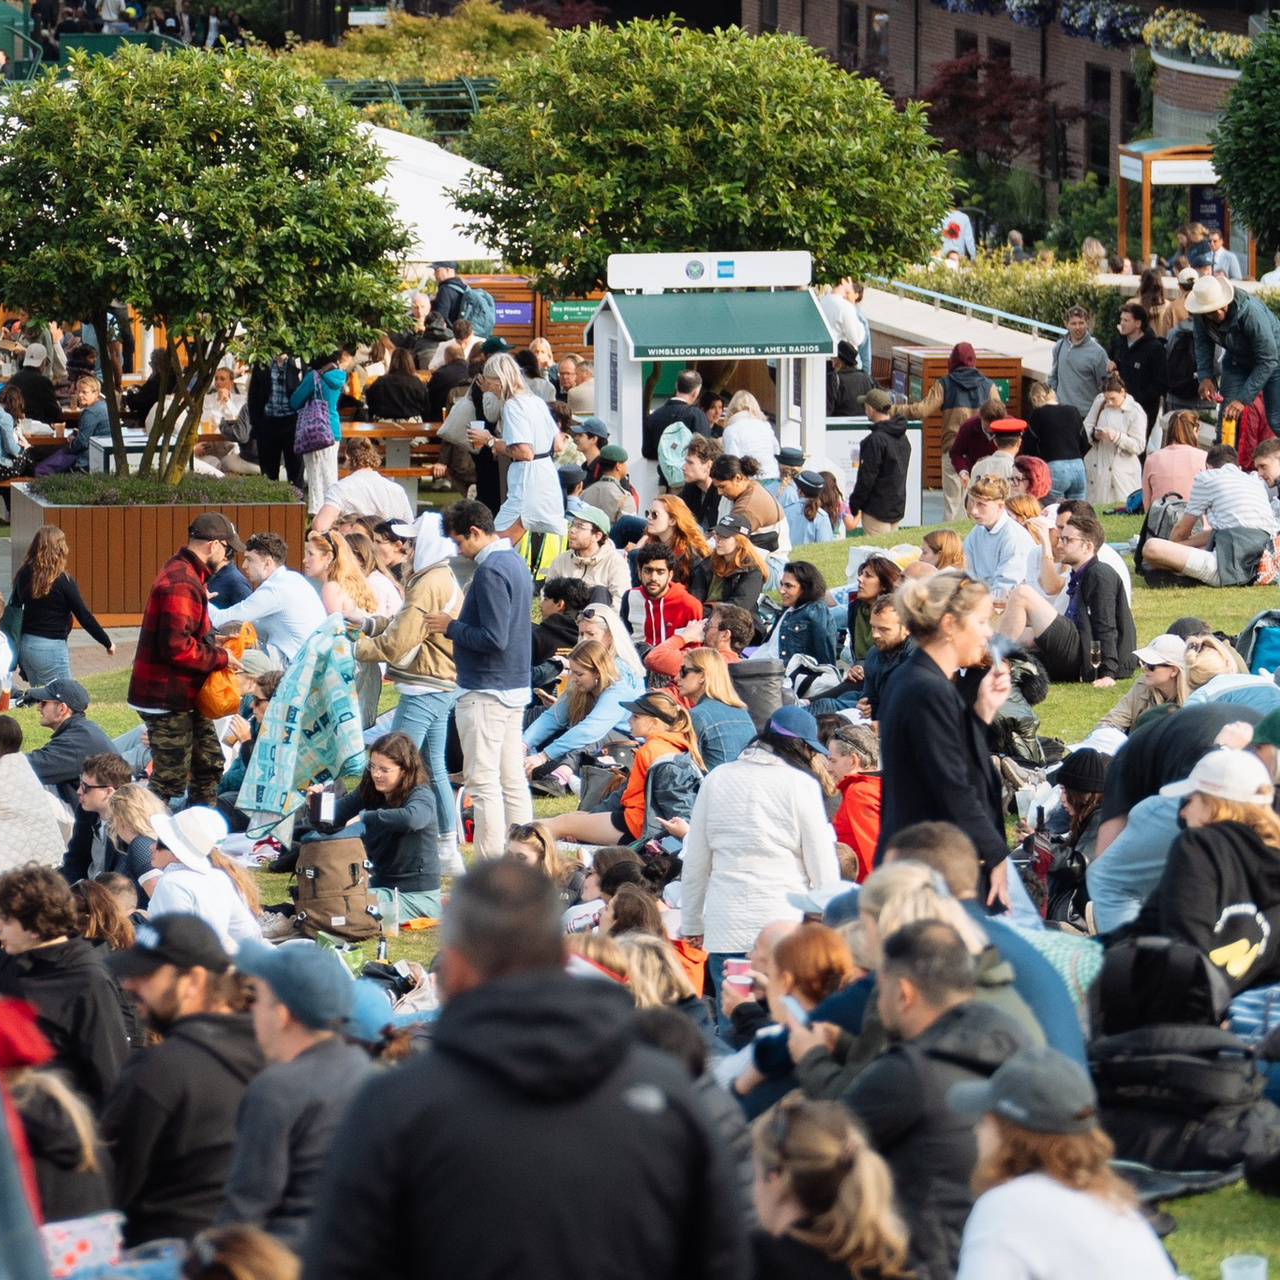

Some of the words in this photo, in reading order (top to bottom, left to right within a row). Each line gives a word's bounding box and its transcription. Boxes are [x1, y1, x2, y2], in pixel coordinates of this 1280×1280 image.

[647, 347, 698, 356] WIMBLEDON
[699, 346, 756, 355] PROGRAMMES
[763, 345, 787, 353] AMEX
[788, 345, 820, 353] RADIOS
